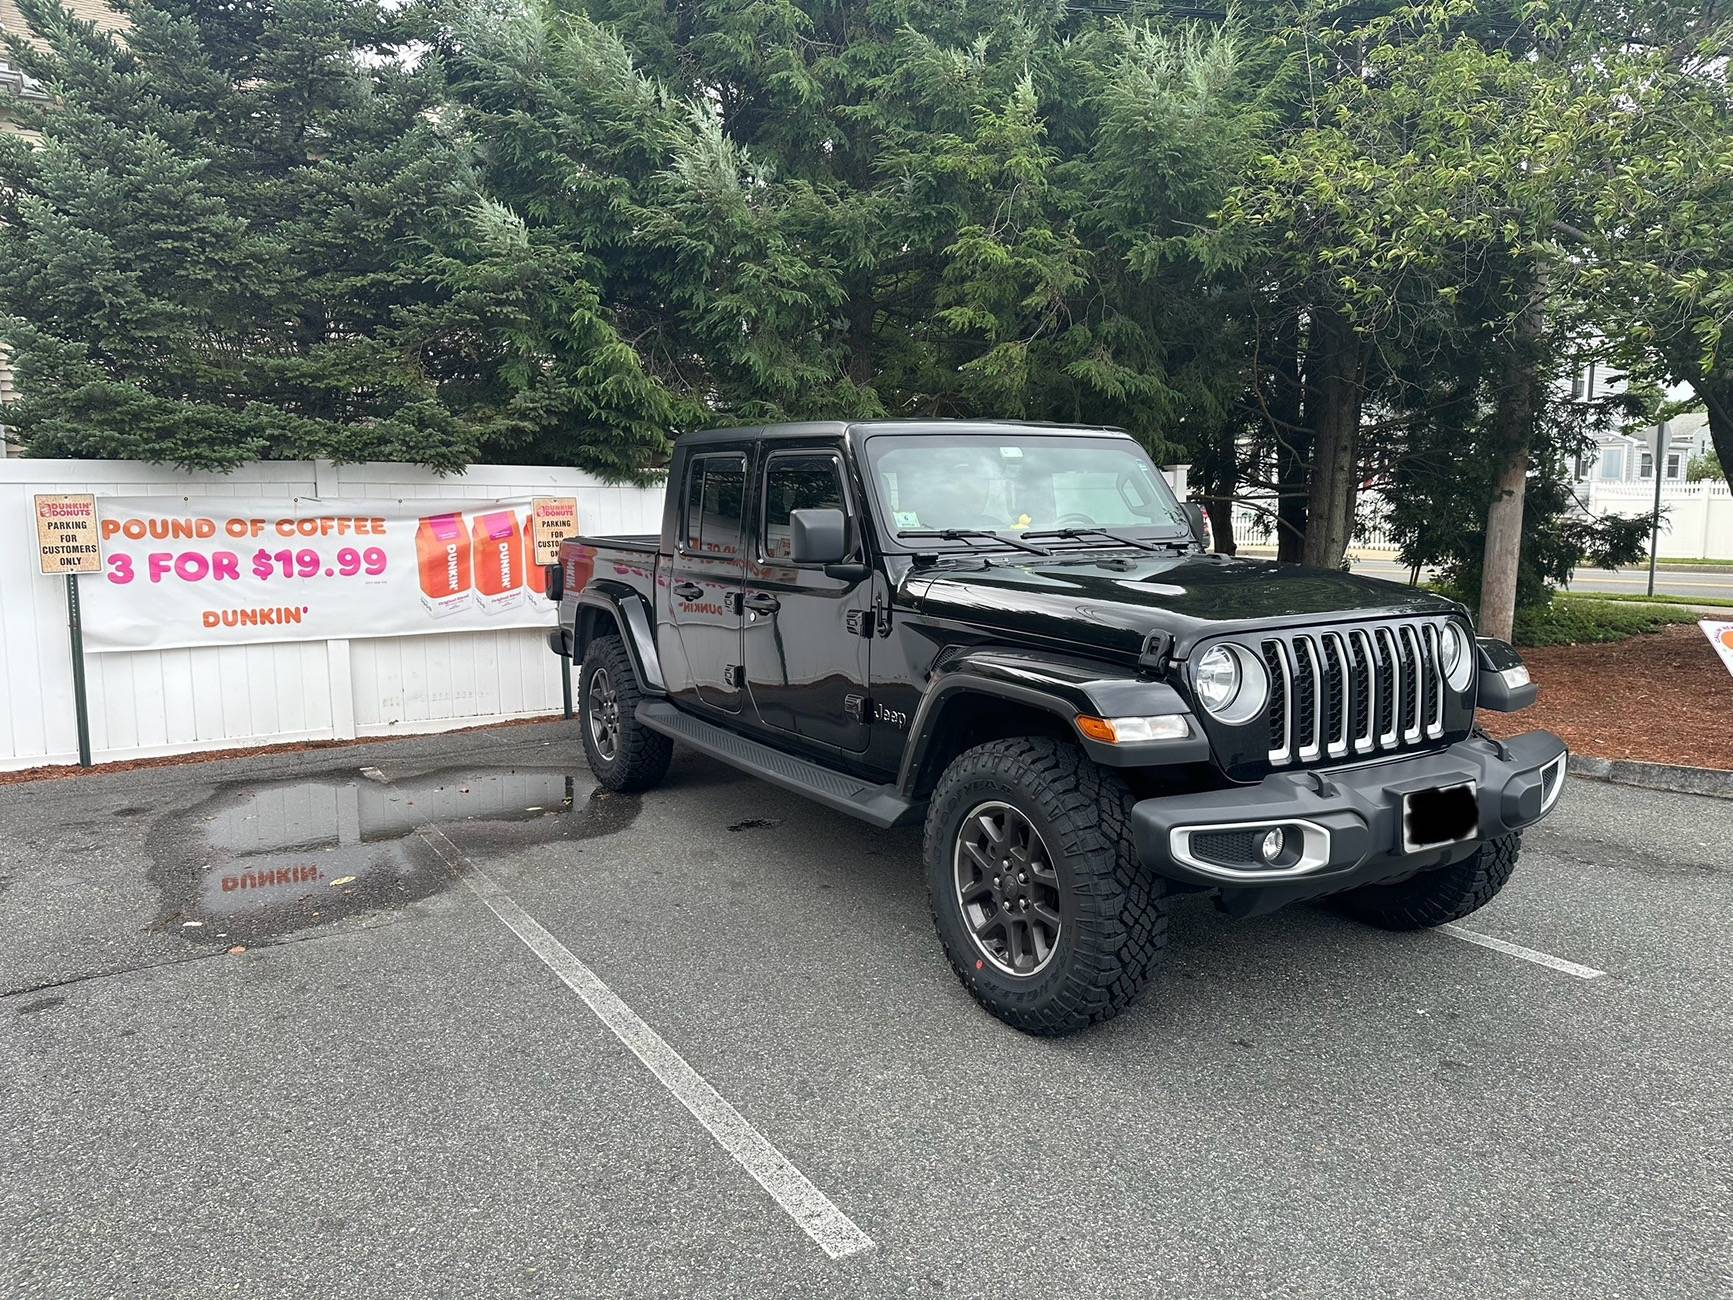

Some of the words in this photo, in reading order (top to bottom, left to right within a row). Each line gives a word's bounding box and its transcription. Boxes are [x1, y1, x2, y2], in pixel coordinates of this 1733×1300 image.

[47, 521, 87, 530] PARKING
[101, 518, 216, 540] POUND
[225, 518, 266, 538] OF
[275, 516, 387, 537] COFFEE
[542, 520, 571, 528] PARKING
[60, 534, 77, 543] FOR
[538, 540, 560, 548] CUSTO
[42, 545, 97, 555] CUSTOMERS
[59, 557, 81, 566] ONLY
[107, 553, 134, 584] 3
[148, 551, 240, 583] FOR
[252, 547, 387, 580] $19.99
[202, 606, 308, 628] DUNKIN'
[873, 703, 907, 729] Jeep
